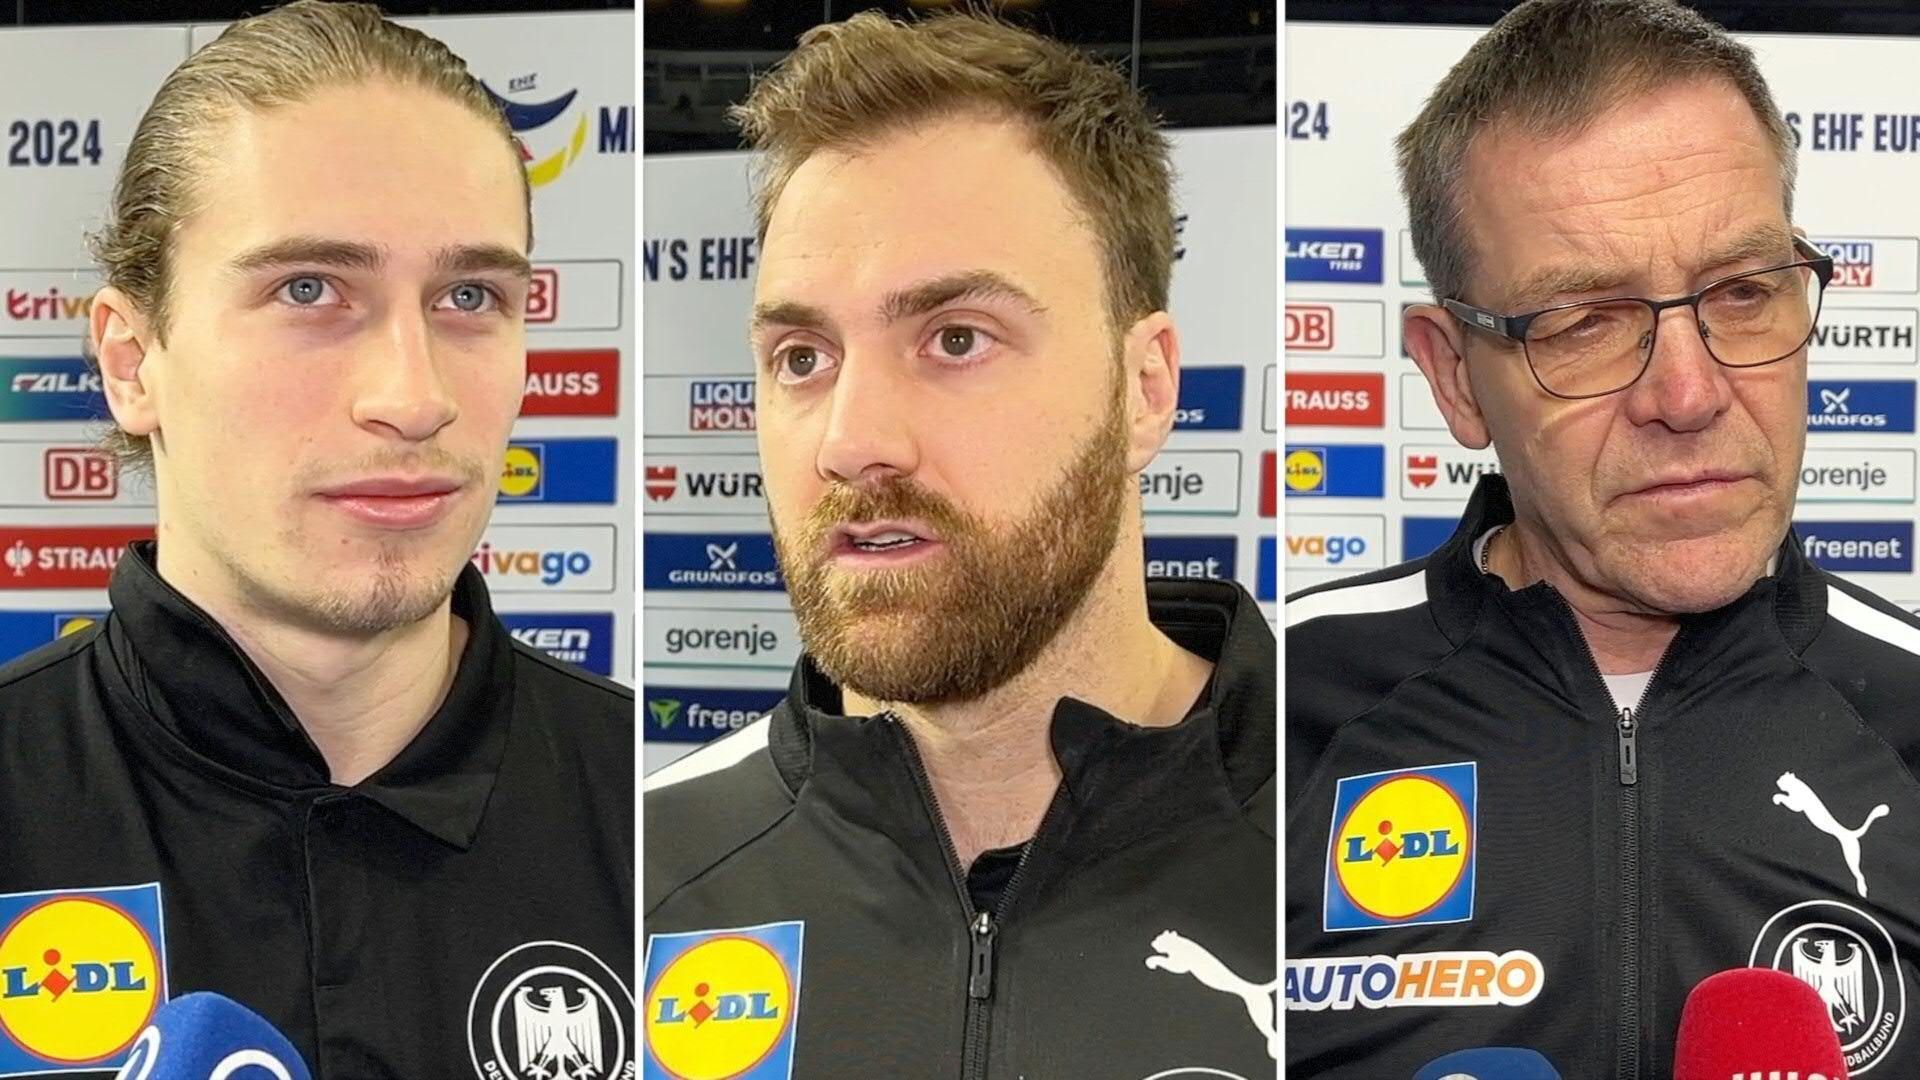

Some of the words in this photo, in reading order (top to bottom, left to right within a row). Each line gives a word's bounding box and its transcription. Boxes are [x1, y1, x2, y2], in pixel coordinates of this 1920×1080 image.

[1285, 101, 1330, 140] 24
[1813, 113, 1863, 151] EHF
[9, 120, 102, 166] 2024
[699, 238, 756, 281] EHF
[525, 372, 601, 396] AUSS
[54, 457, 109, 491] DB
[1801, 462, 1887, 491] orenje
[1804, 536, 1902, 559] freenet
[668, 571, 776, 584] GRUNDFOS
[1146, 557, 1220, 580] enet
[665, 623, 778, 656] gorenje
[1285, 958, 1537, 1004] AUTOHERO
